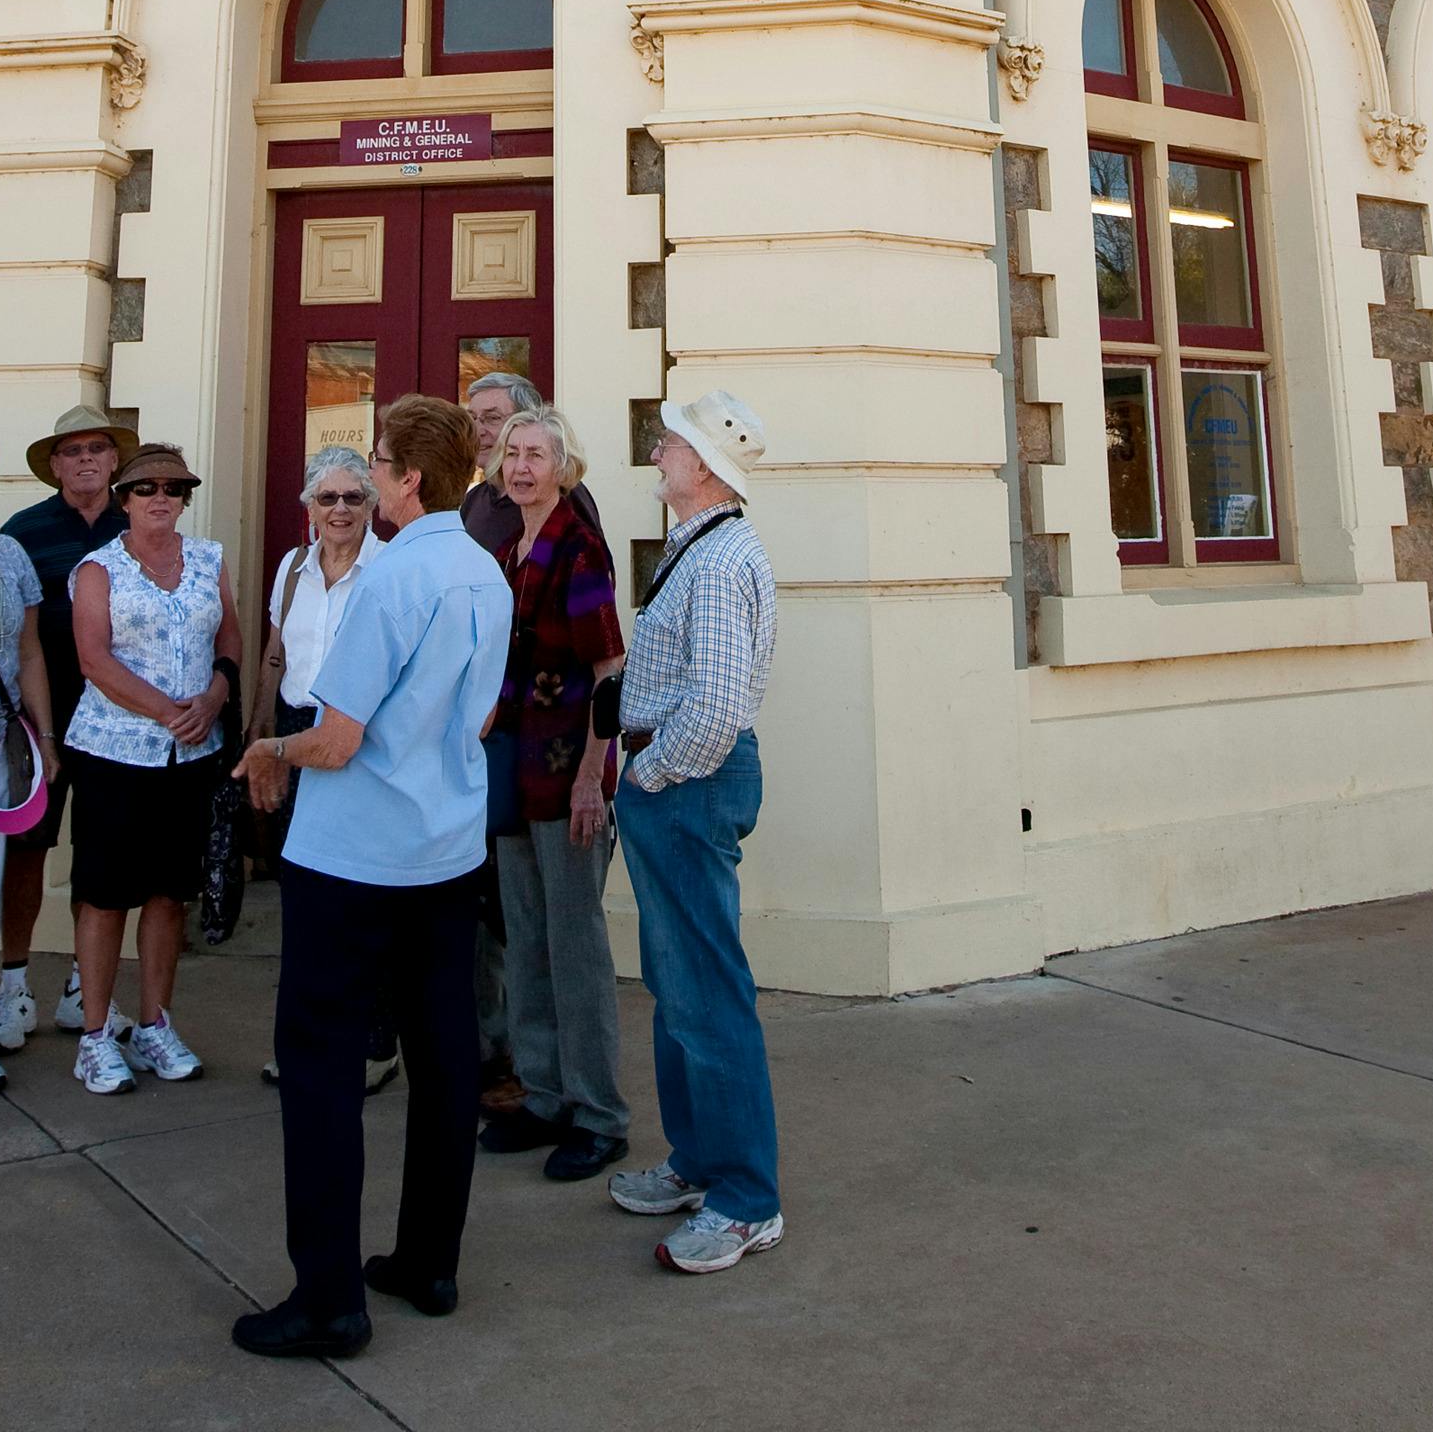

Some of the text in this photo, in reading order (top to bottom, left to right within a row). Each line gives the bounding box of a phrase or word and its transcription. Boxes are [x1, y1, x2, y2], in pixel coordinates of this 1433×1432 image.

[378, 119, 450, 135] C.F.M.E.U.
[356, 133, 473, 149] MINING & GENERAL
[364, 148, 463, 162] DISTRICT OFFICE
[320, 429, 365, 443] HOURS
